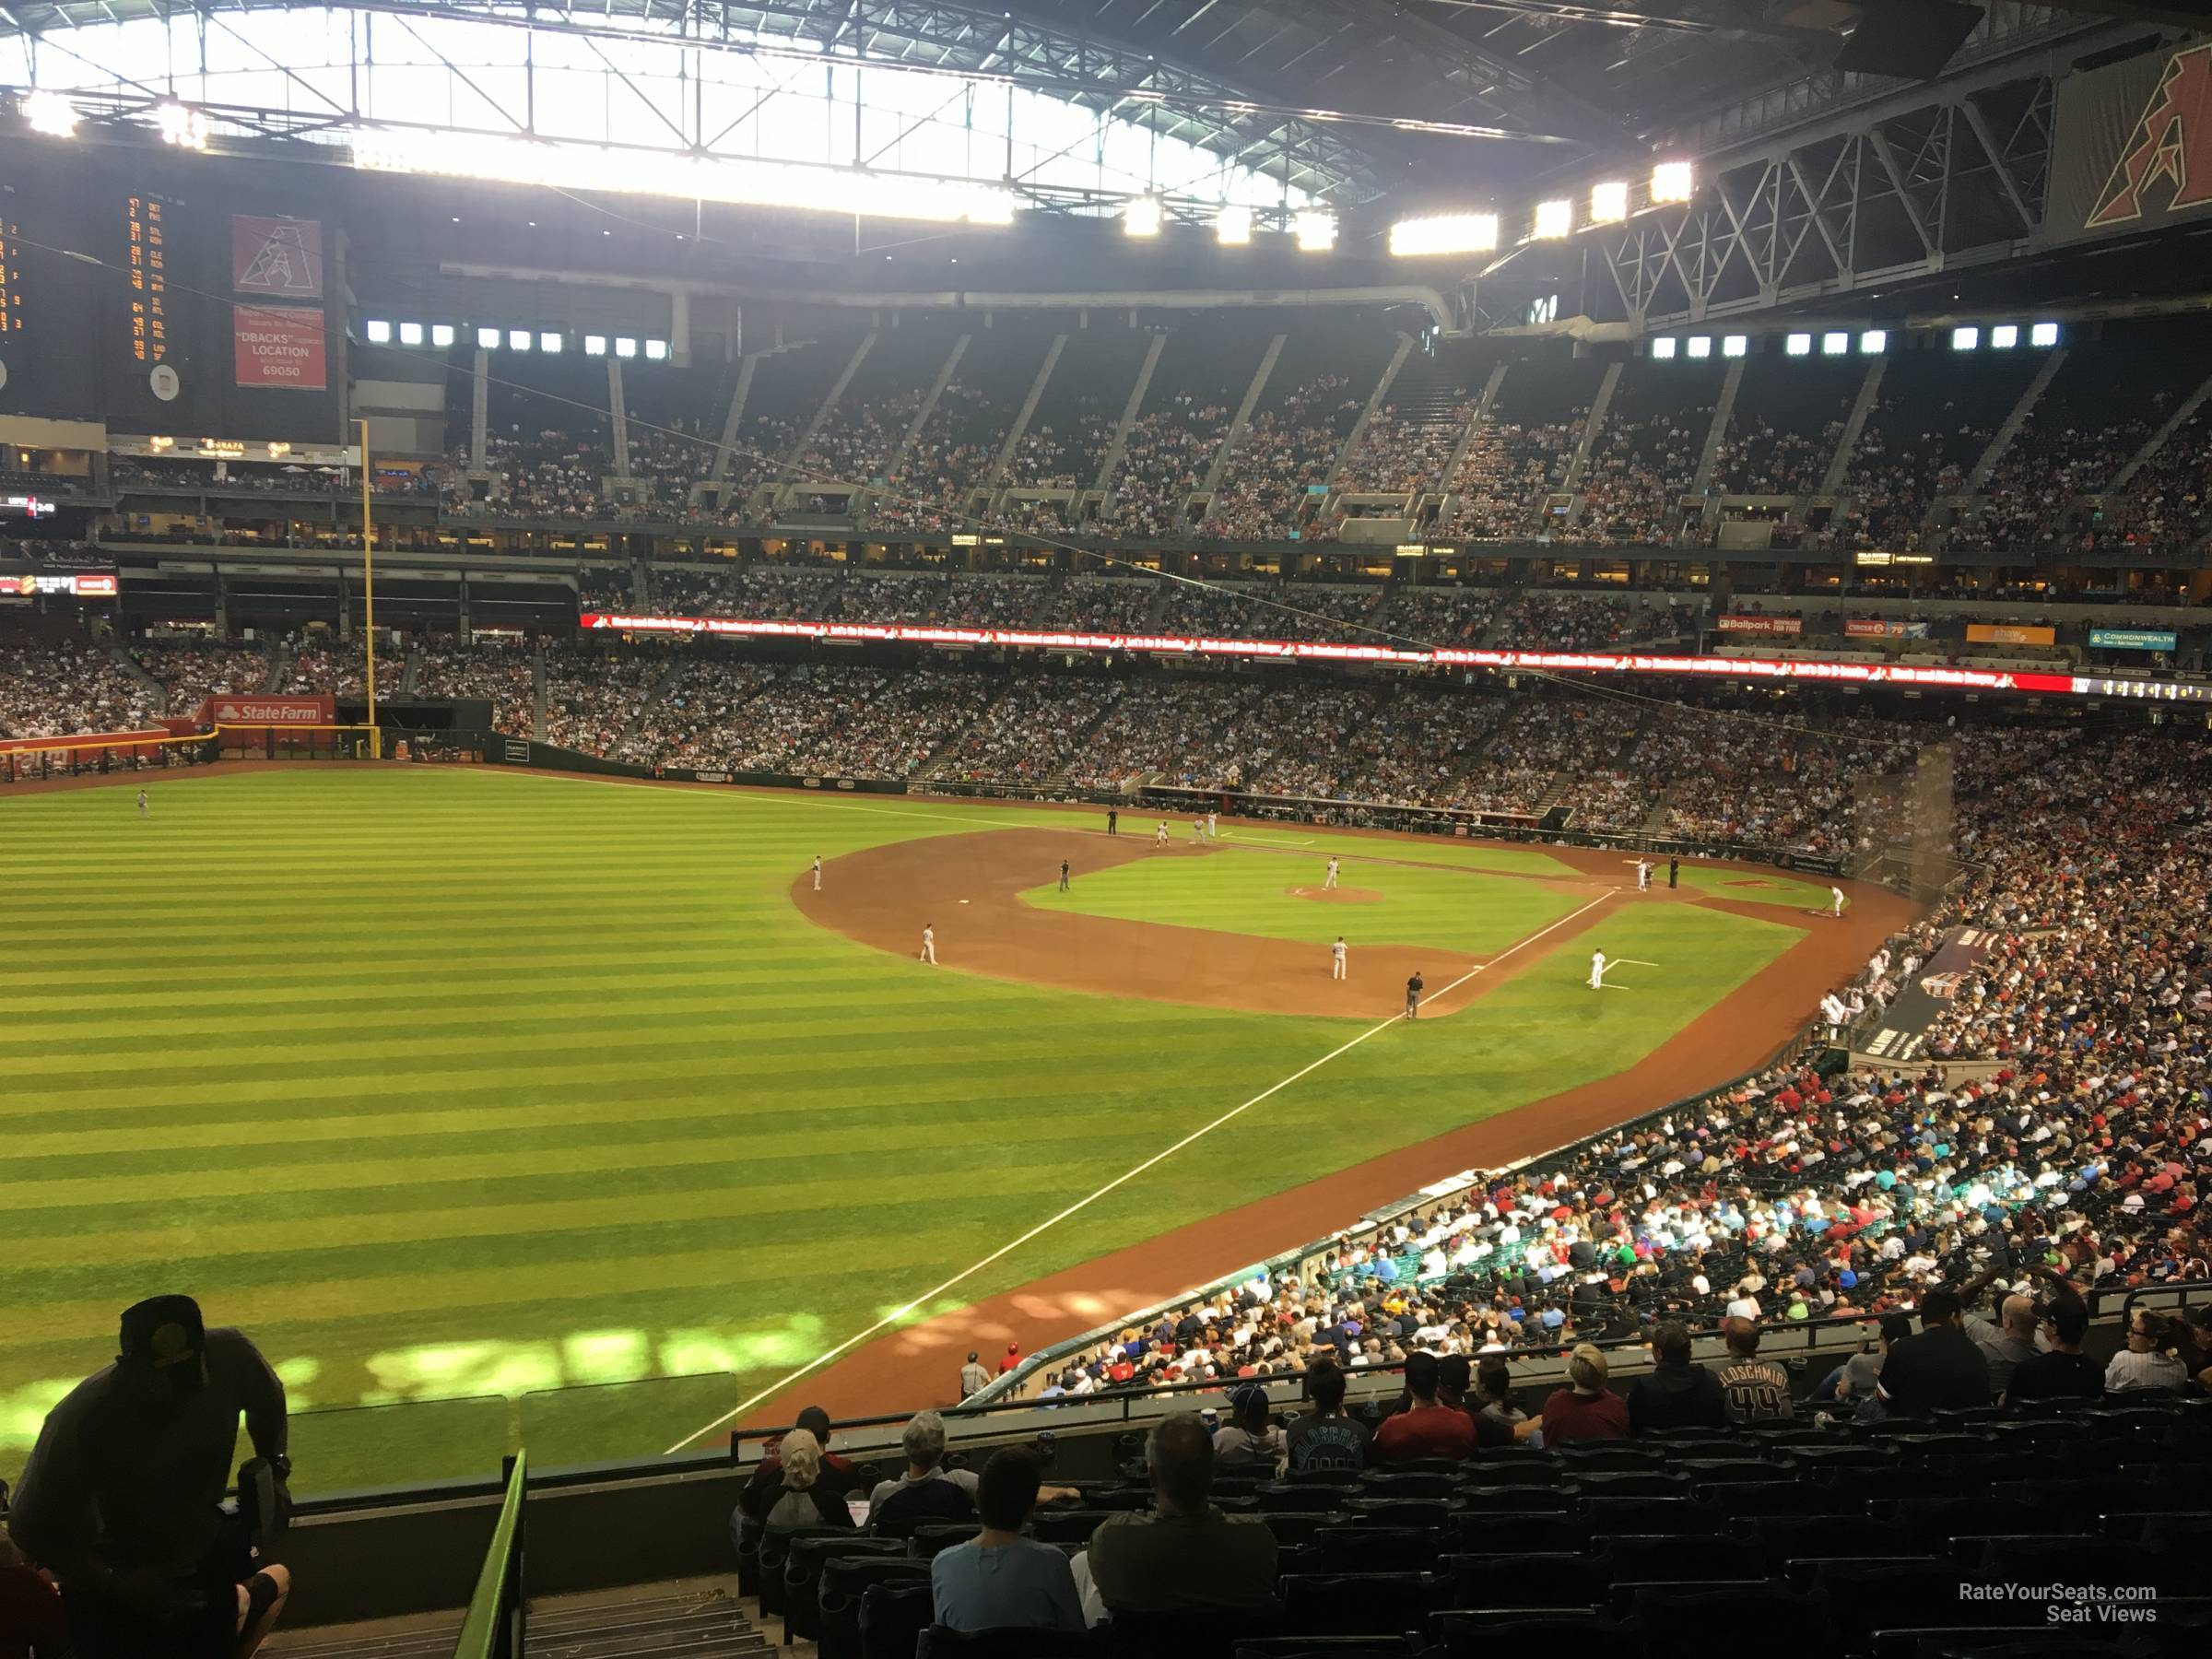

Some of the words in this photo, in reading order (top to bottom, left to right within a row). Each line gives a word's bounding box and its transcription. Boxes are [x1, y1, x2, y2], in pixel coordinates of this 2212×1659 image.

[252, 345, 310, 358] LOCATION
[263, 366, 300, 377] 69050
[1730, 619, 1771, 630] Ballpark
[1848, 624, 1873, 632] CIRCLE
[2104, 632, 2174, 643] COMMONWEALTH
[2181, 689, 2187, 698] 6
[2196, 689, 2203, 699] 7
[241, 705, 276, 720] State
[280, 706, 317, 720] Farm
[1728, 1386, 1783, 1417] 44
